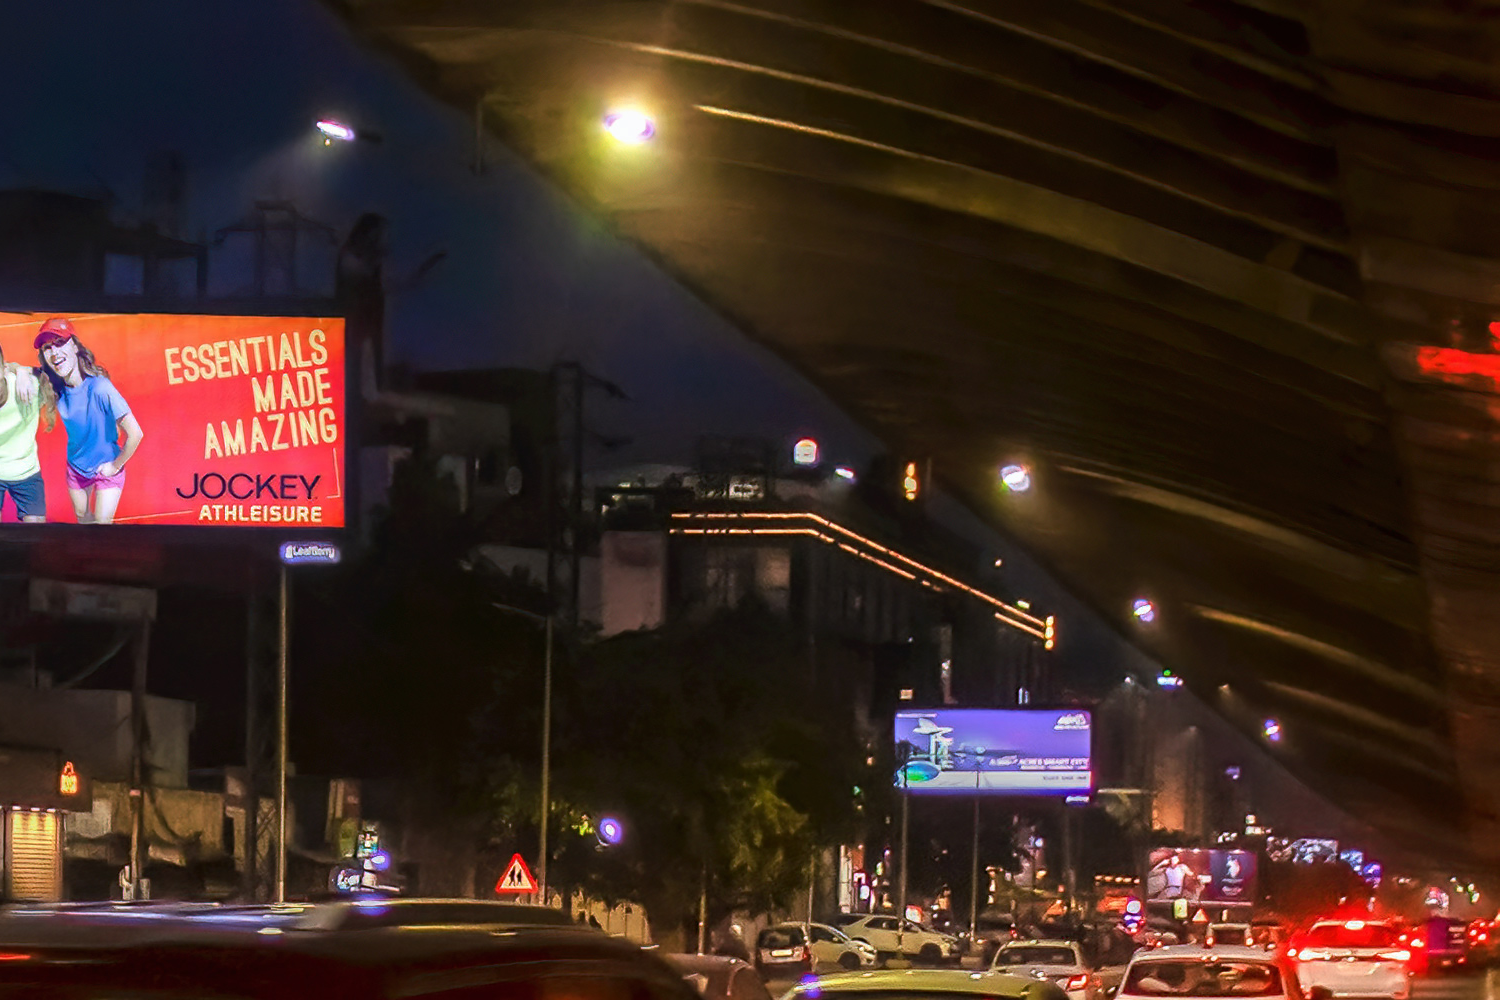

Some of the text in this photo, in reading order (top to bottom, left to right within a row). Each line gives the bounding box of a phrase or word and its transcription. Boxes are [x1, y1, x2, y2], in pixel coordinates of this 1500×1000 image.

[165, 329, 328, 385] ESSENTIALS
[252, 368, 332, 413] MADE
[205, 407, 337, 459] AMAZING
[176, 472, 321, 500] JOCKEY
[199, 504, 322, 522] ATHLEISURE
